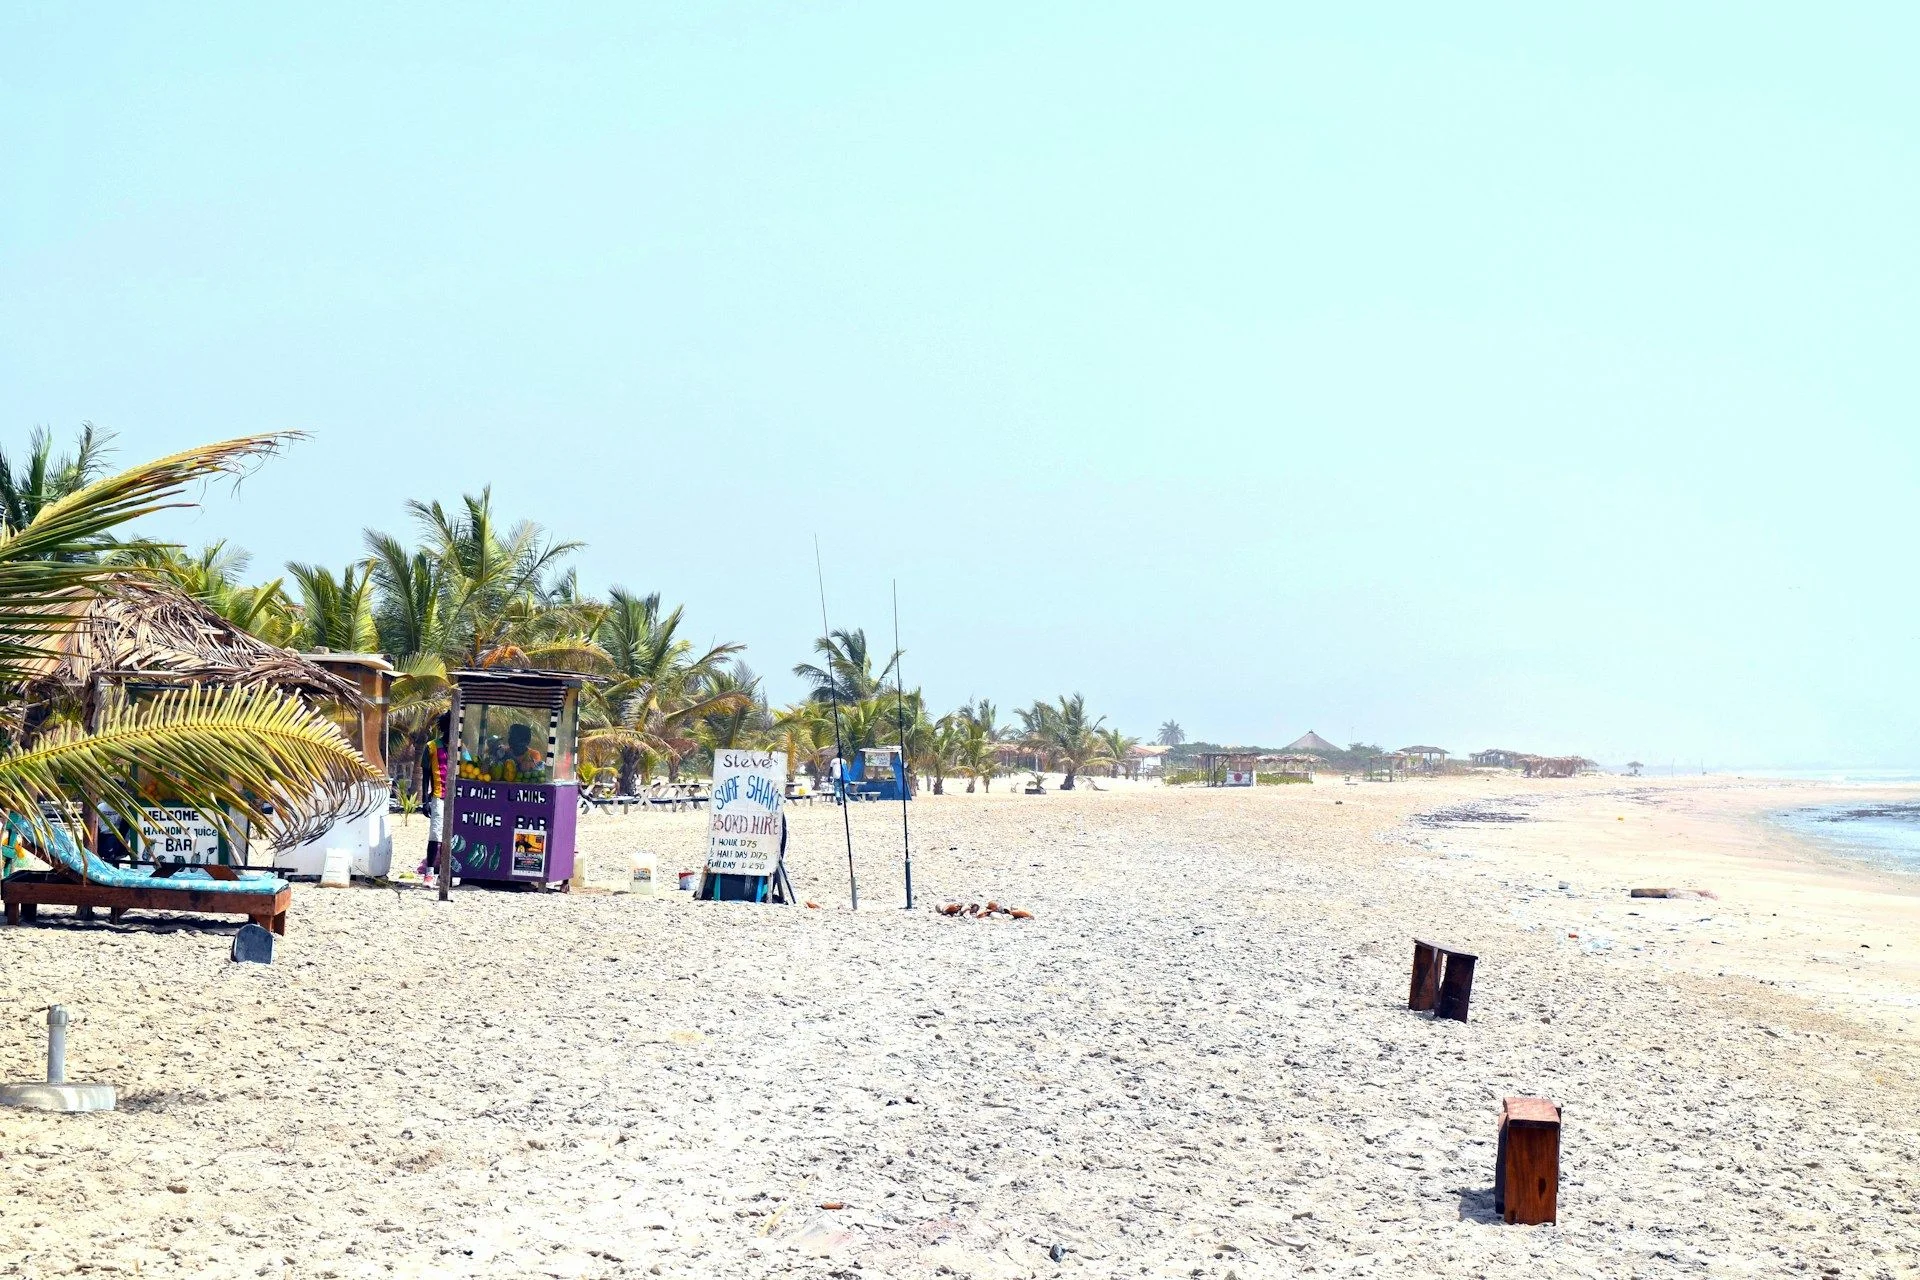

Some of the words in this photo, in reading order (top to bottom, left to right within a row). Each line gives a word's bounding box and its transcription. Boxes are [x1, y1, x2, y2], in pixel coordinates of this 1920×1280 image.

[455, 785, 497, 800] ELCOME
[714, 775, 740, 810] SURF
[461, 811, 502, 827] JUICE
[516, 816, 547, 830] BAR
[751, 815, 779, 835] HIRE
[165, 838, 193, 852] BAR
[718, 838, 738, 847] HOUR
[735, 850, 748, 859] DAY
